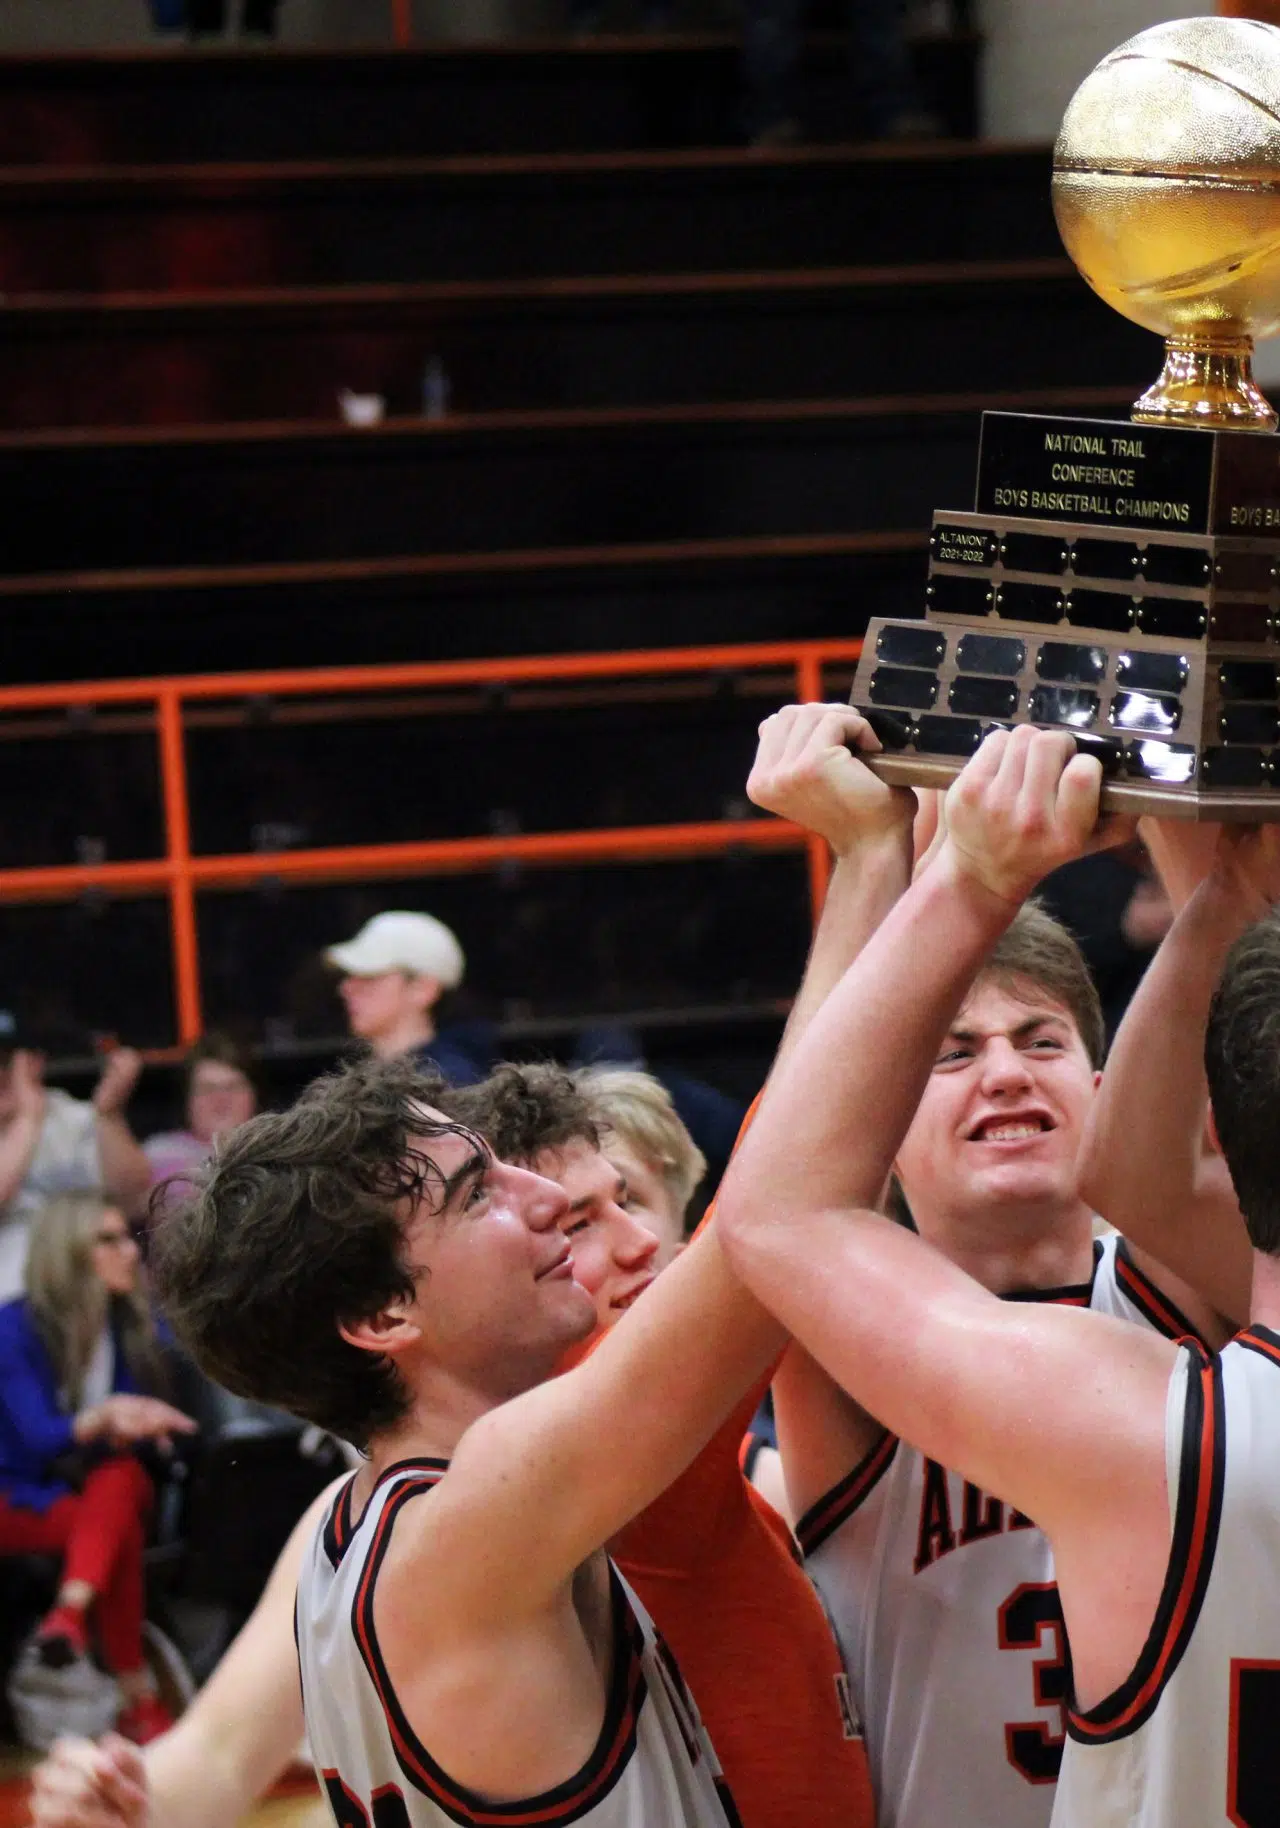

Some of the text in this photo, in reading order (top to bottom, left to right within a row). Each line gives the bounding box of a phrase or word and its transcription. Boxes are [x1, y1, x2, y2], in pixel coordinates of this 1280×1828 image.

[1044, 433, 1146, 458] NATIONAL TRAIL
[1051, 463, 1136, 487] CONFERENCE
[994, 488, 1190, 522] BOYS BASKETBALL CHAMPIONS
[1230, 506, 1262, 527] BOYS
[940, 532, 988, 547] ALTAMONT
[940, 547, 984, 563] 2021-2022
